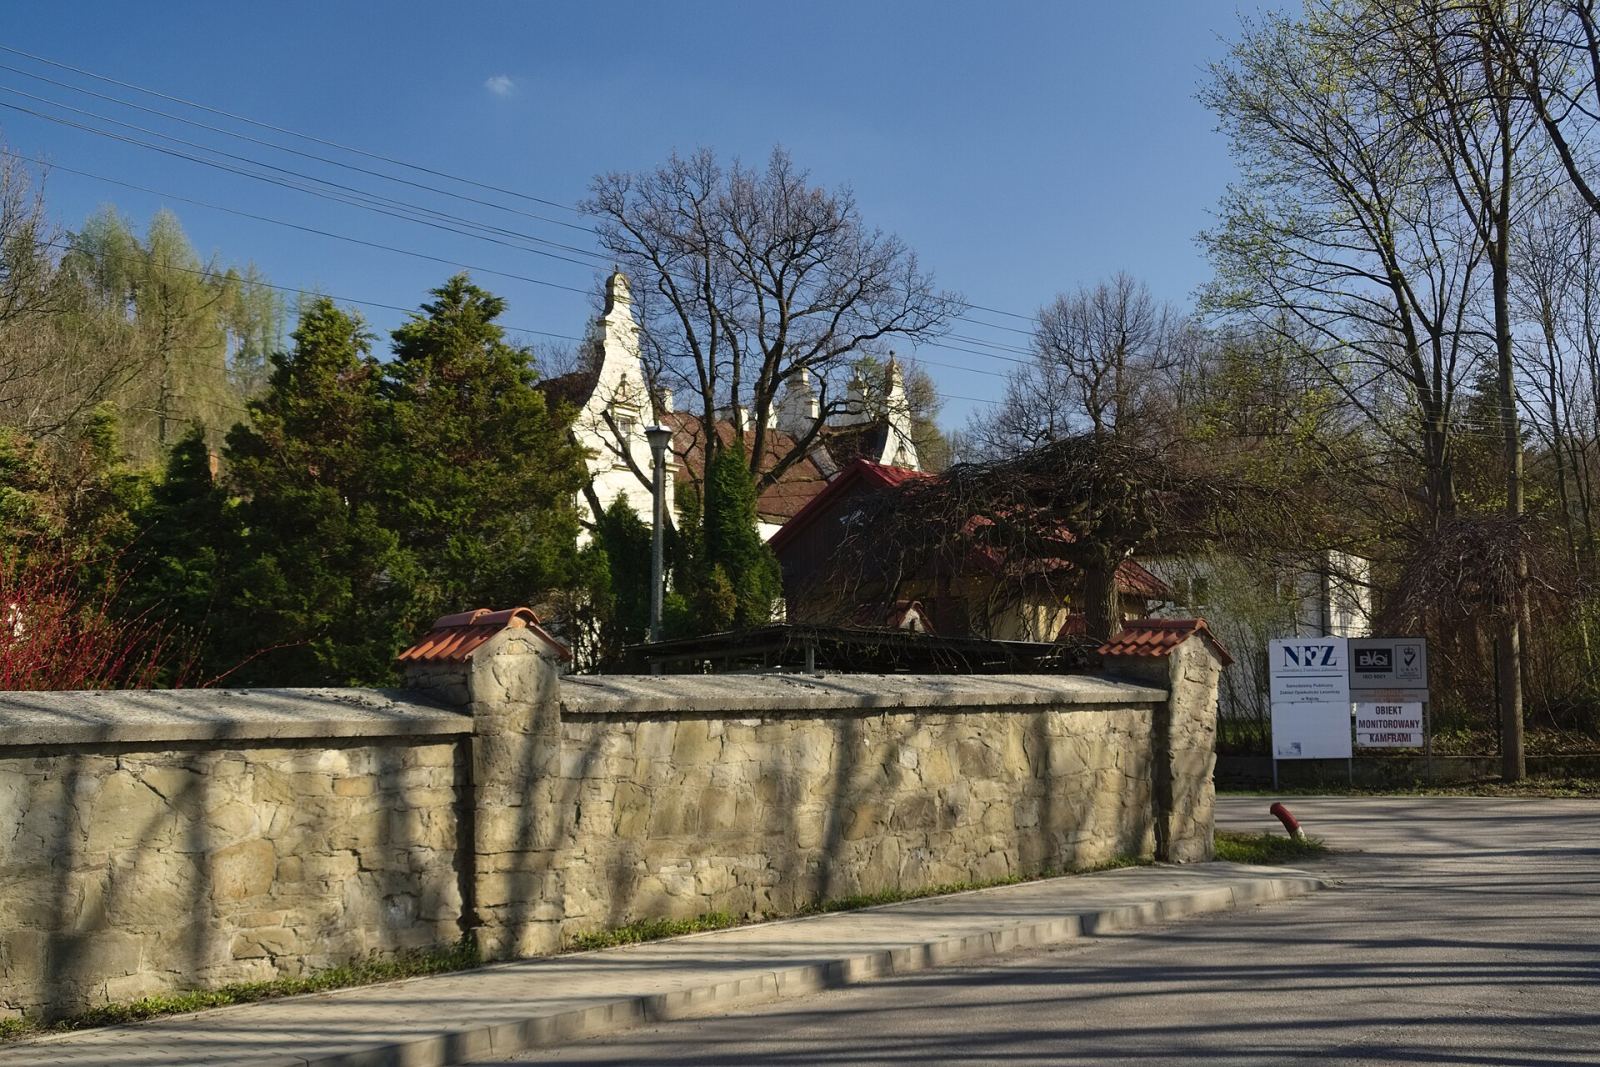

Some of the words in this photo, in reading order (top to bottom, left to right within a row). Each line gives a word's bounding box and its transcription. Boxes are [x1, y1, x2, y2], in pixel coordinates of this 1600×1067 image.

[1282, 645, 1337, 667] NFZ
[1375, 705, 1403, 715] OBIEKT
[1358, 719, 1420, 729] MONITOROWANY
